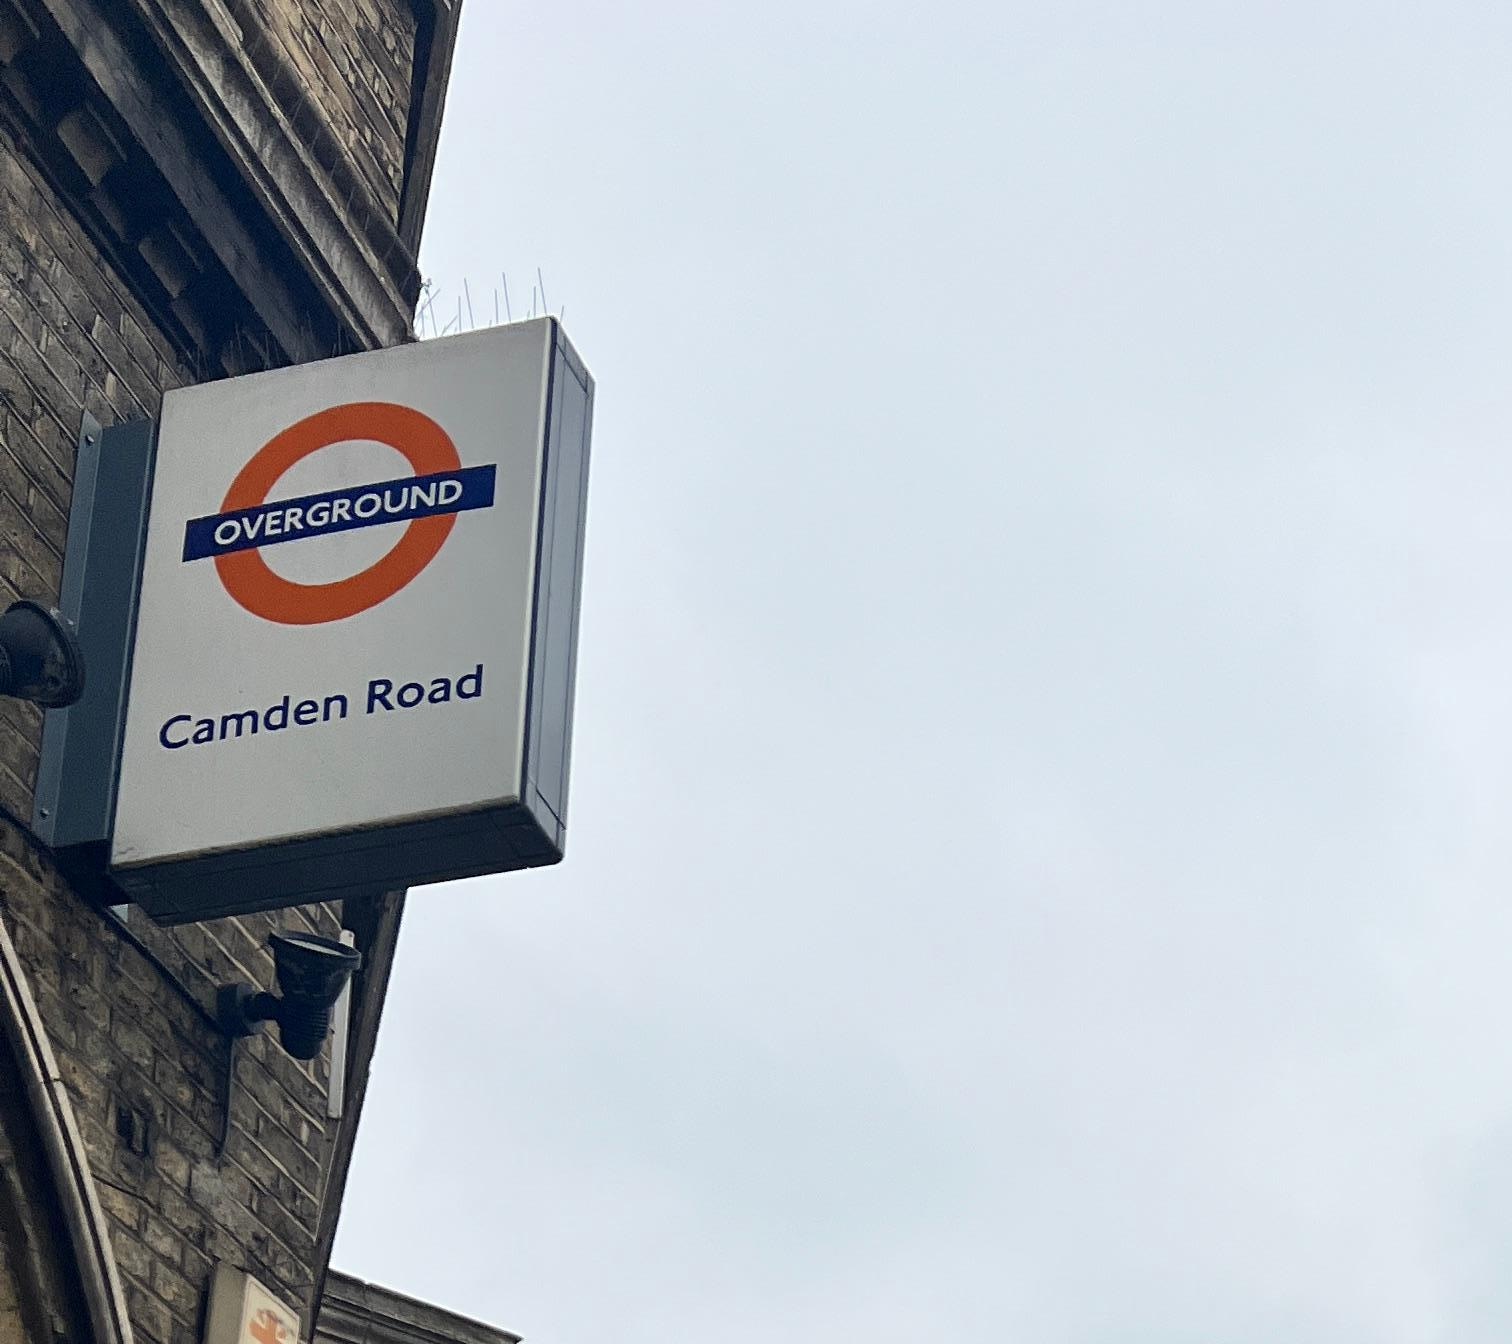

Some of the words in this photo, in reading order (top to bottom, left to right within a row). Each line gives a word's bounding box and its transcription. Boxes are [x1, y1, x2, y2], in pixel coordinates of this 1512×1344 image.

[213, 478, 464, 546] OVERGROUND
[158, 690, 348, 750] Camden
[365, 663, 485, 714] Road
